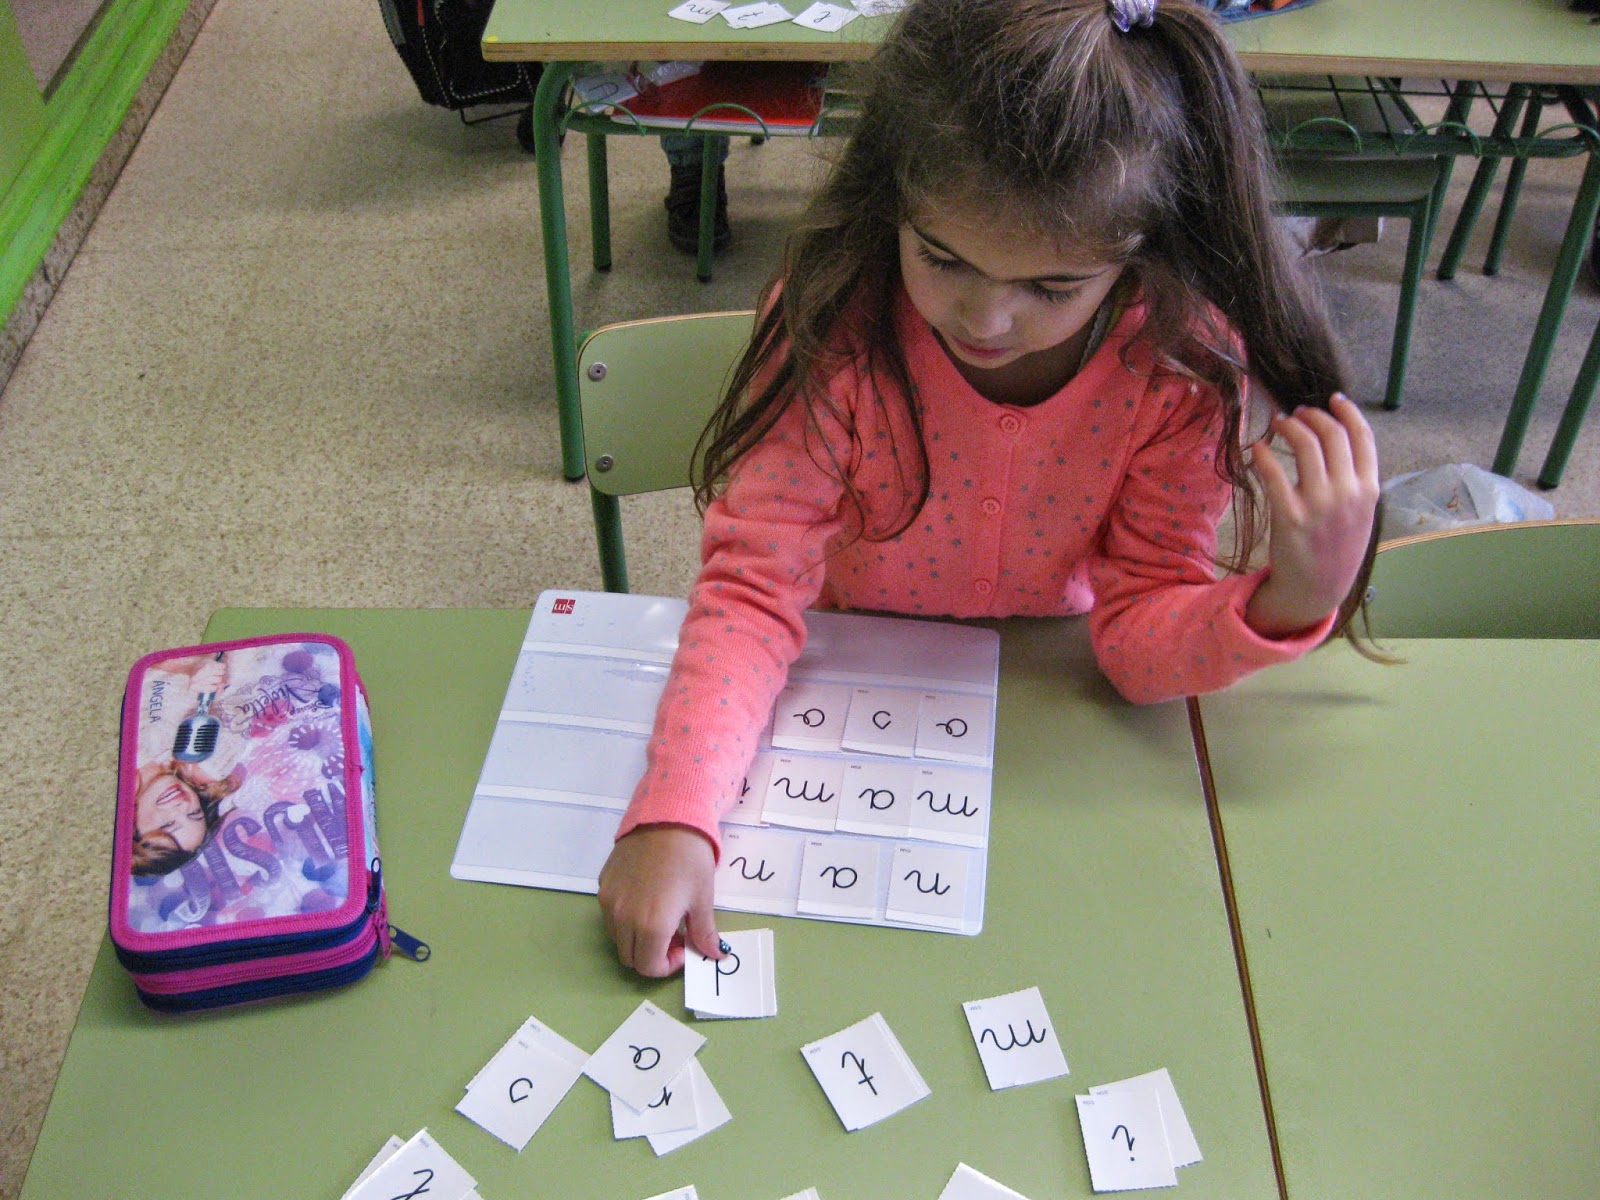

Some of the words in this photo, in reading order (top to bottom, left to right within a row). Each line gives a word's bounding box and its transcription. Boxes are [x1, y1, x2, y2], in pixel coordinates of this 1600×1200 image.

[149, 680, 171, 724] ÁNGELA
[235, 683, 311, 720] Violetta
[980, 1019, 1047, 1051] m
